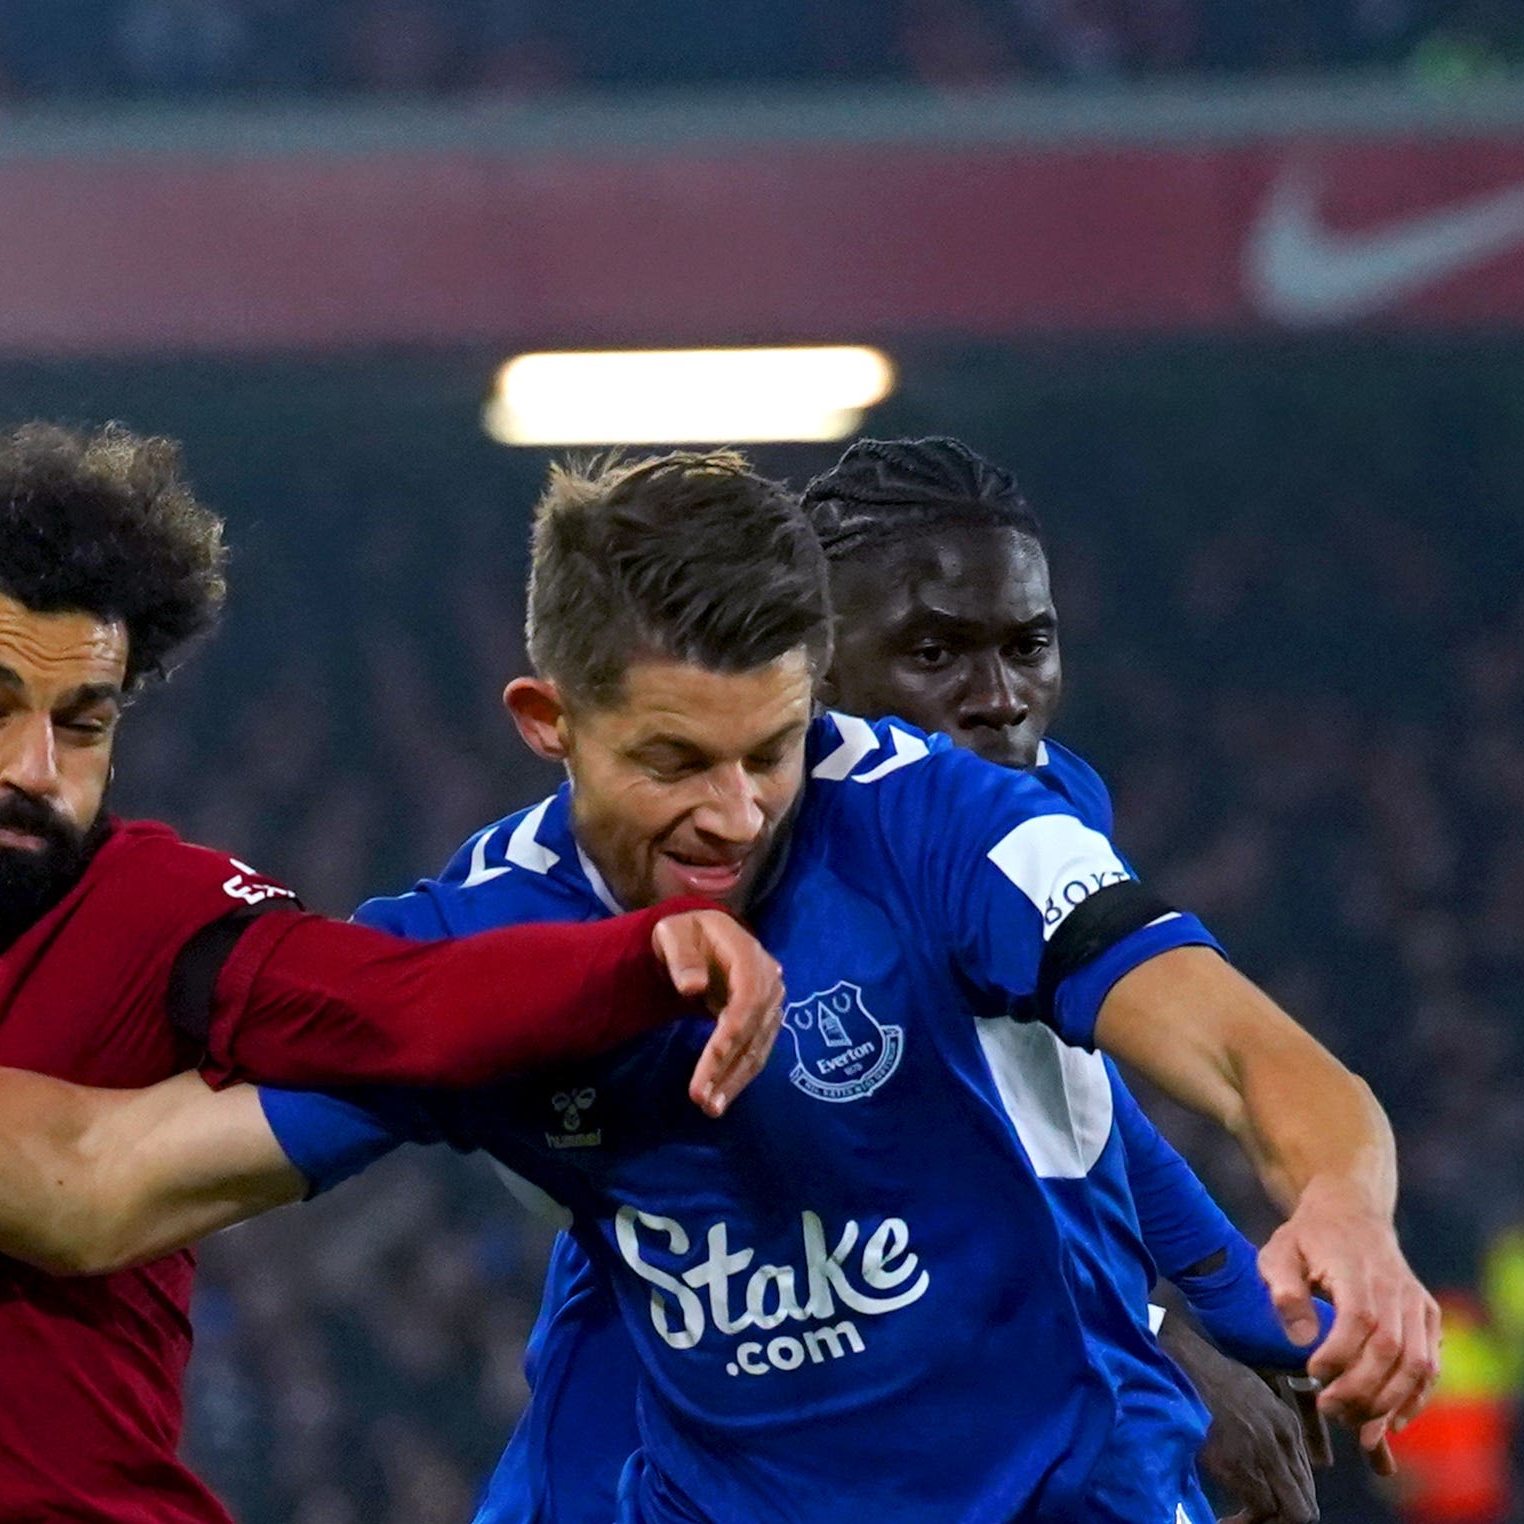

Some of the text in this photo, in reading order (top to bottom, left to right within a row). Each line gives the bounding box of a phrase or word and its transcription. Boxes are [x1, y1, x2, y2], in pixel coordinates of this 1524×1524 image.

[816, 1041, 876, 1075] Everton
[615, 1209, 931, 1349] Stake
[726, 1320, 866, 1377] .com
